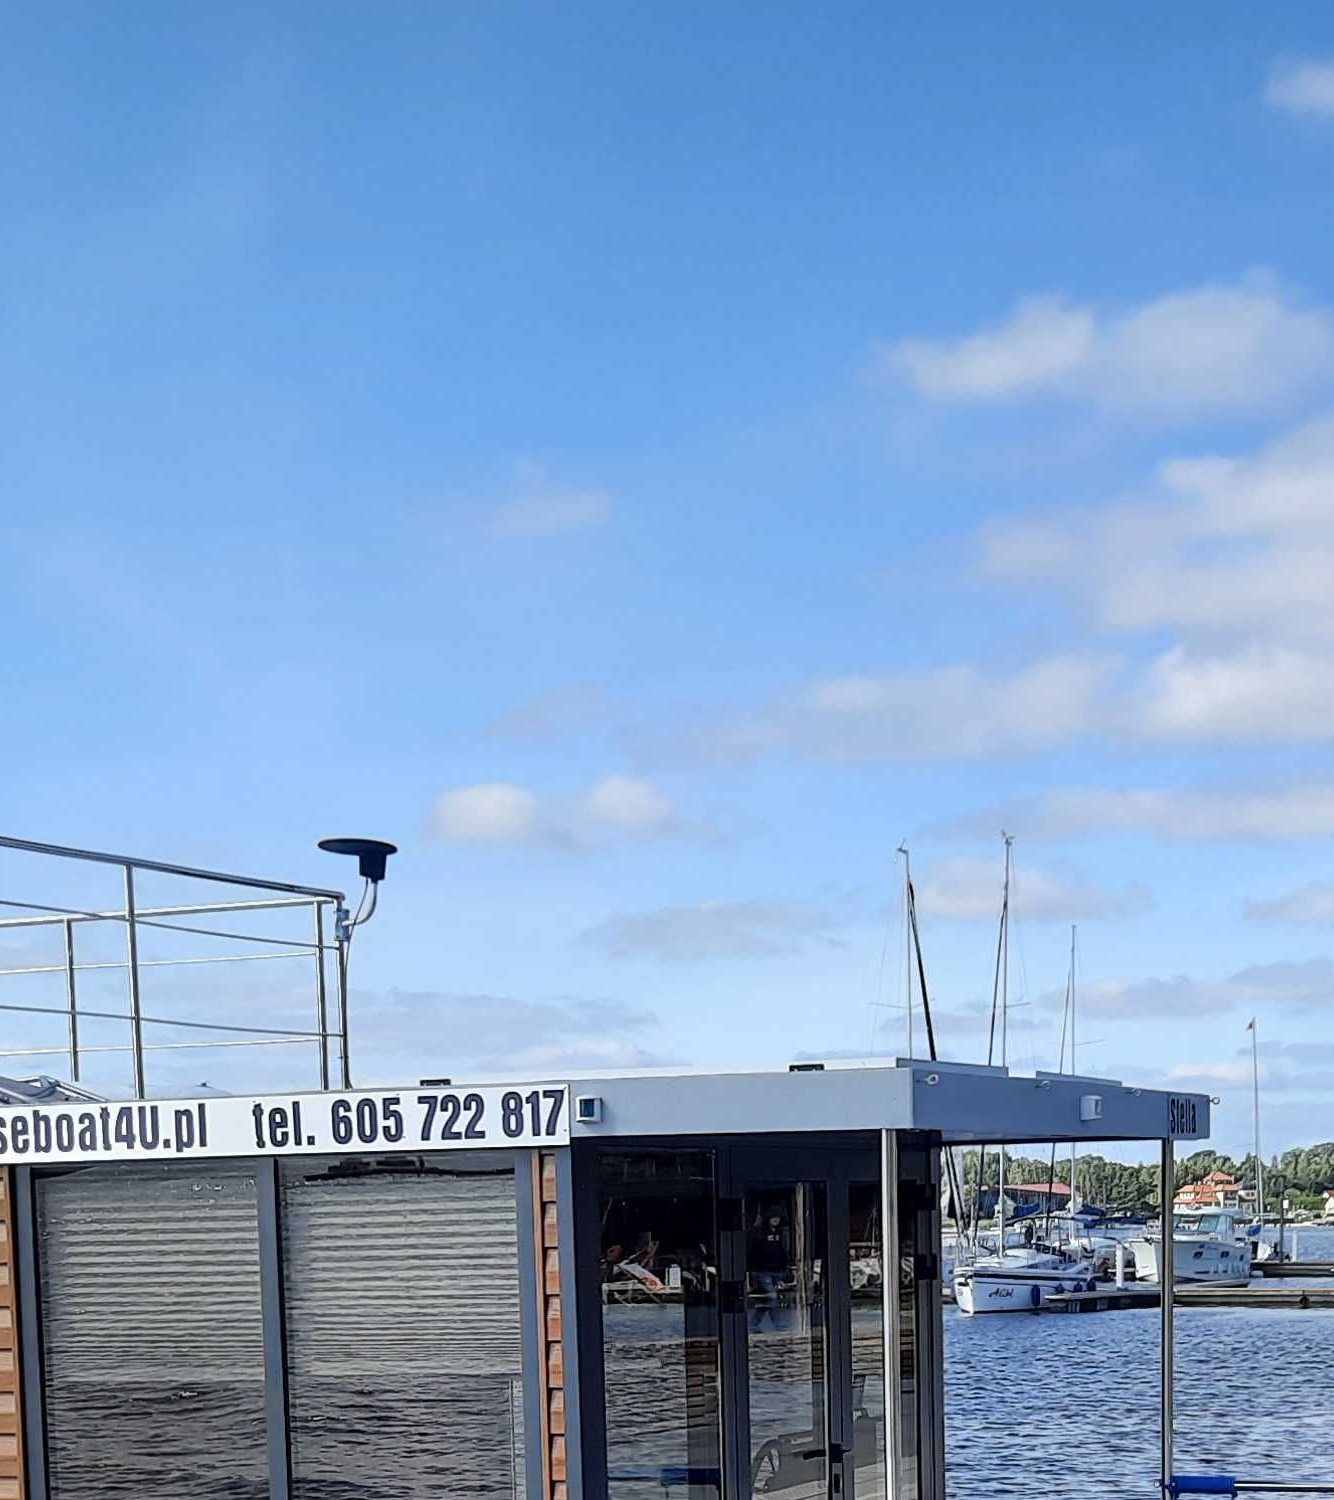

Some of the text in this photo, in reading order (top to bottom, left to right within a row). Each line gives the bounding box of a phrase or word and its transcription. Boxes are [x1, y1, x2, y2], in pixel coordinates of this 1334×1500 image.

[252, 1101, 315, 1148] tel.
[331, 1098, 404, 1144] 605
[418, 1093, 486, 1141] 722
[501, 1089, 565, 1138] 817
[1170, 1098, 1196, 1134] Stella
